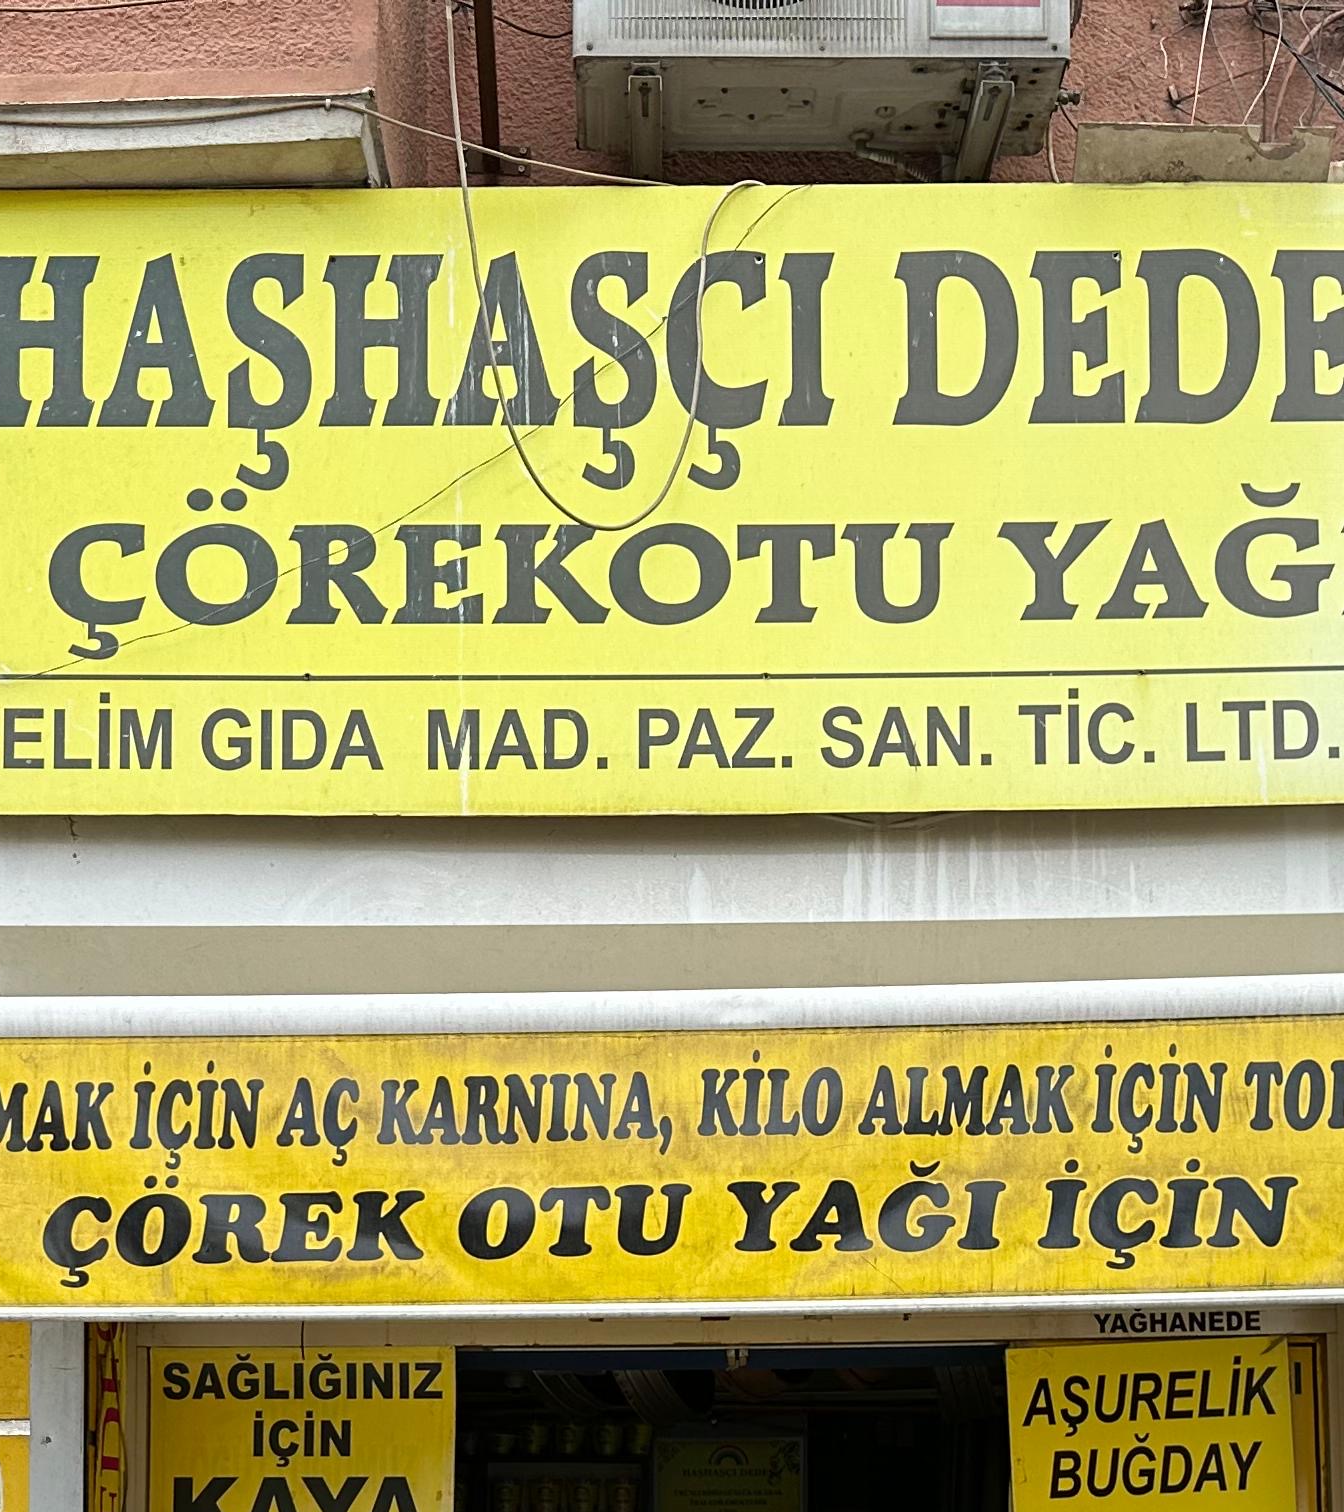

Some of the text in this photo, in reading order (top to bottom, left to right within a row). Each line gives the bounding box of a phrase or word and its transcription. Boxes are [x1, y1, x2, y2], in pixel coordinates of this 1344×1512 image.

[48, 488, 953, 660] ÇÖREKOTU
[201, 707, 382, 771] GIDA
[428, 706, 607, 771] MAD.
[640, 705, 792, 769] PAZ.
[821, 704, 991, 768] SAN.
[1019, 687, 1156, 766] TİC.
[1186, 699, 1340, 762] LTD.
[130, 1060, 261, 1169] İÇİN
[278, 1076, 359, 1167] AÇ
[377, 1071, 673, 1156] KARNINA,
[698, 1049, 842, 1137] KİLO
[859, 1063, 1073, 1136] ALMAK
[1094, 1043, 1227, 1155] İÇİN
[42, 1157, 1299, 1289] ÇÖREK OTU YAĞI İÇİN
[1094, 1308, 1261, 1334] YAĞHANEDE
[162, 1353, 443, 1400] SAĞLIĞINIZ
[1022, 1356, 1277, 1437] AŞURELİK
[253, 1410, 351, 1467] İÇİN
[1049, 1432, 1262, 1499] BUĞDAY
